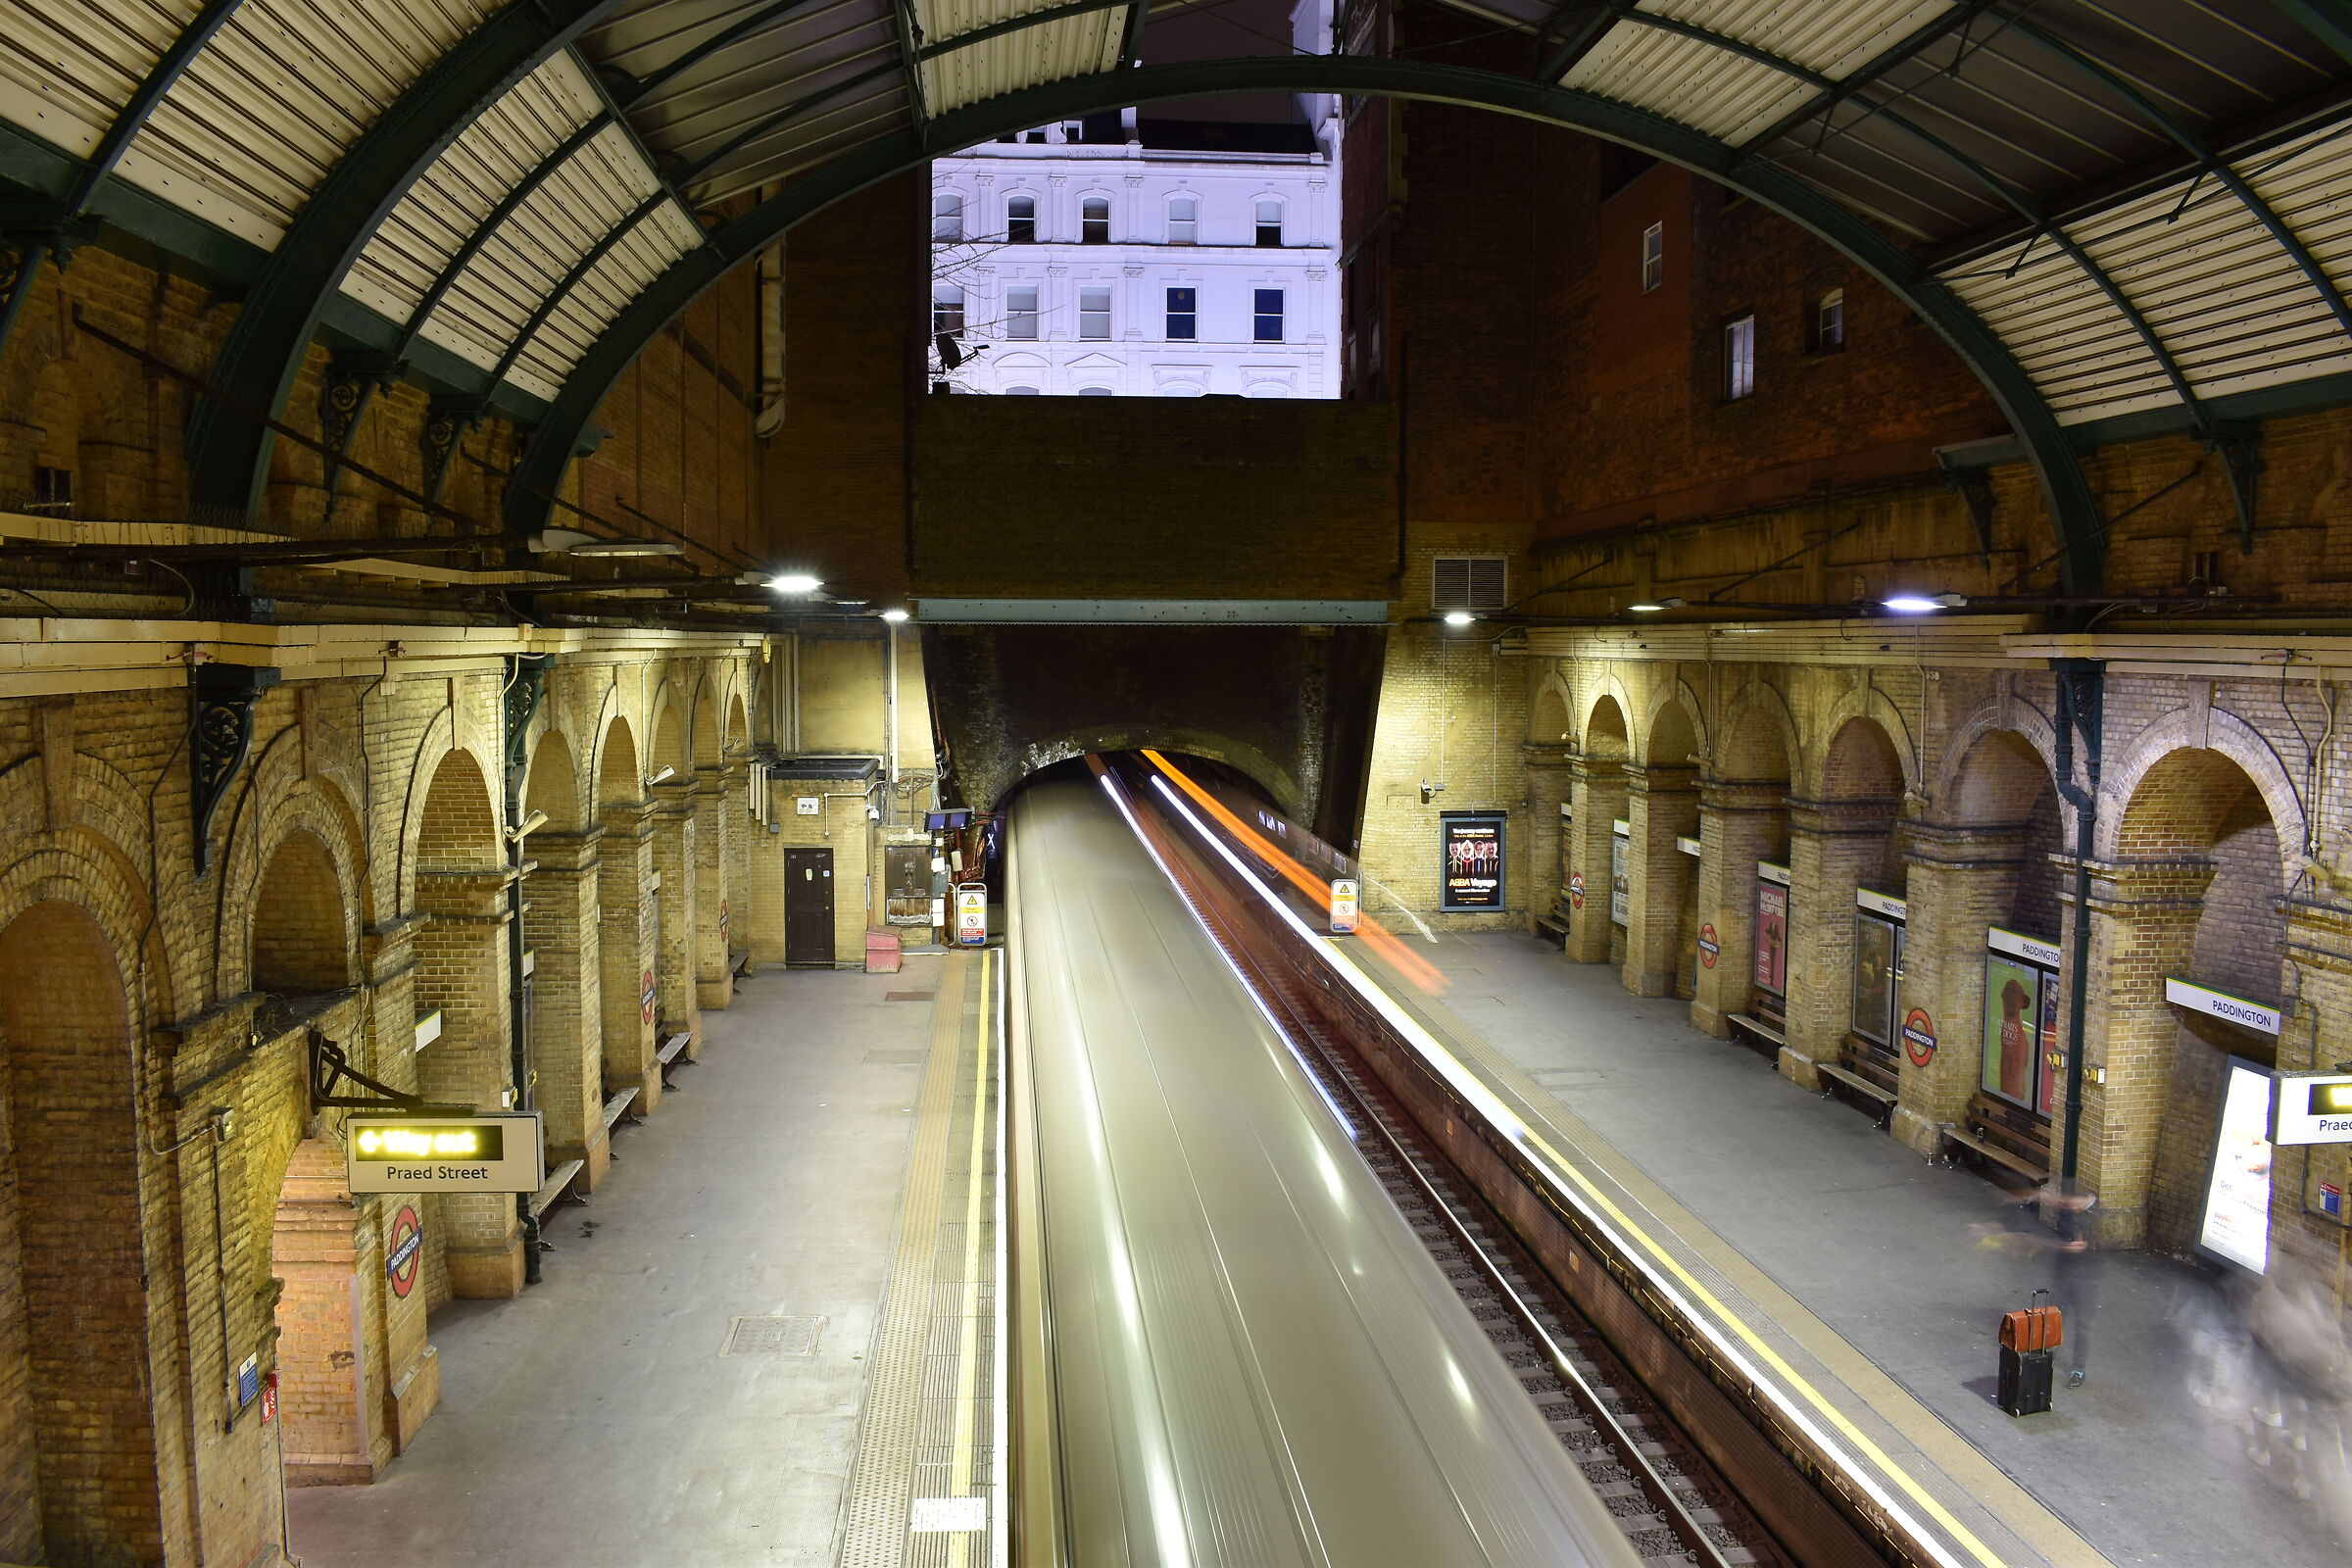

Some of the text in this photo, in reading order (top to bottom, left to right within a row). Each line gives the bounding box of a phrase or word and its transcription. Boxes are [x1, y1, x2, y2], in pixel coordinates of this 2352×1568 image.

[1449, 878, 1470, 887] ABBA
[1760, 890, 1785, 907] MICHAEL
[2212, 1000, 2272, 1027] PADDINGTON
[1905, 1028, 1934, 1047] PADDINGTON
[387, 1166, 488, 1179] Praed Street
[390, 1232, 419, 1270] PADDINGTON
